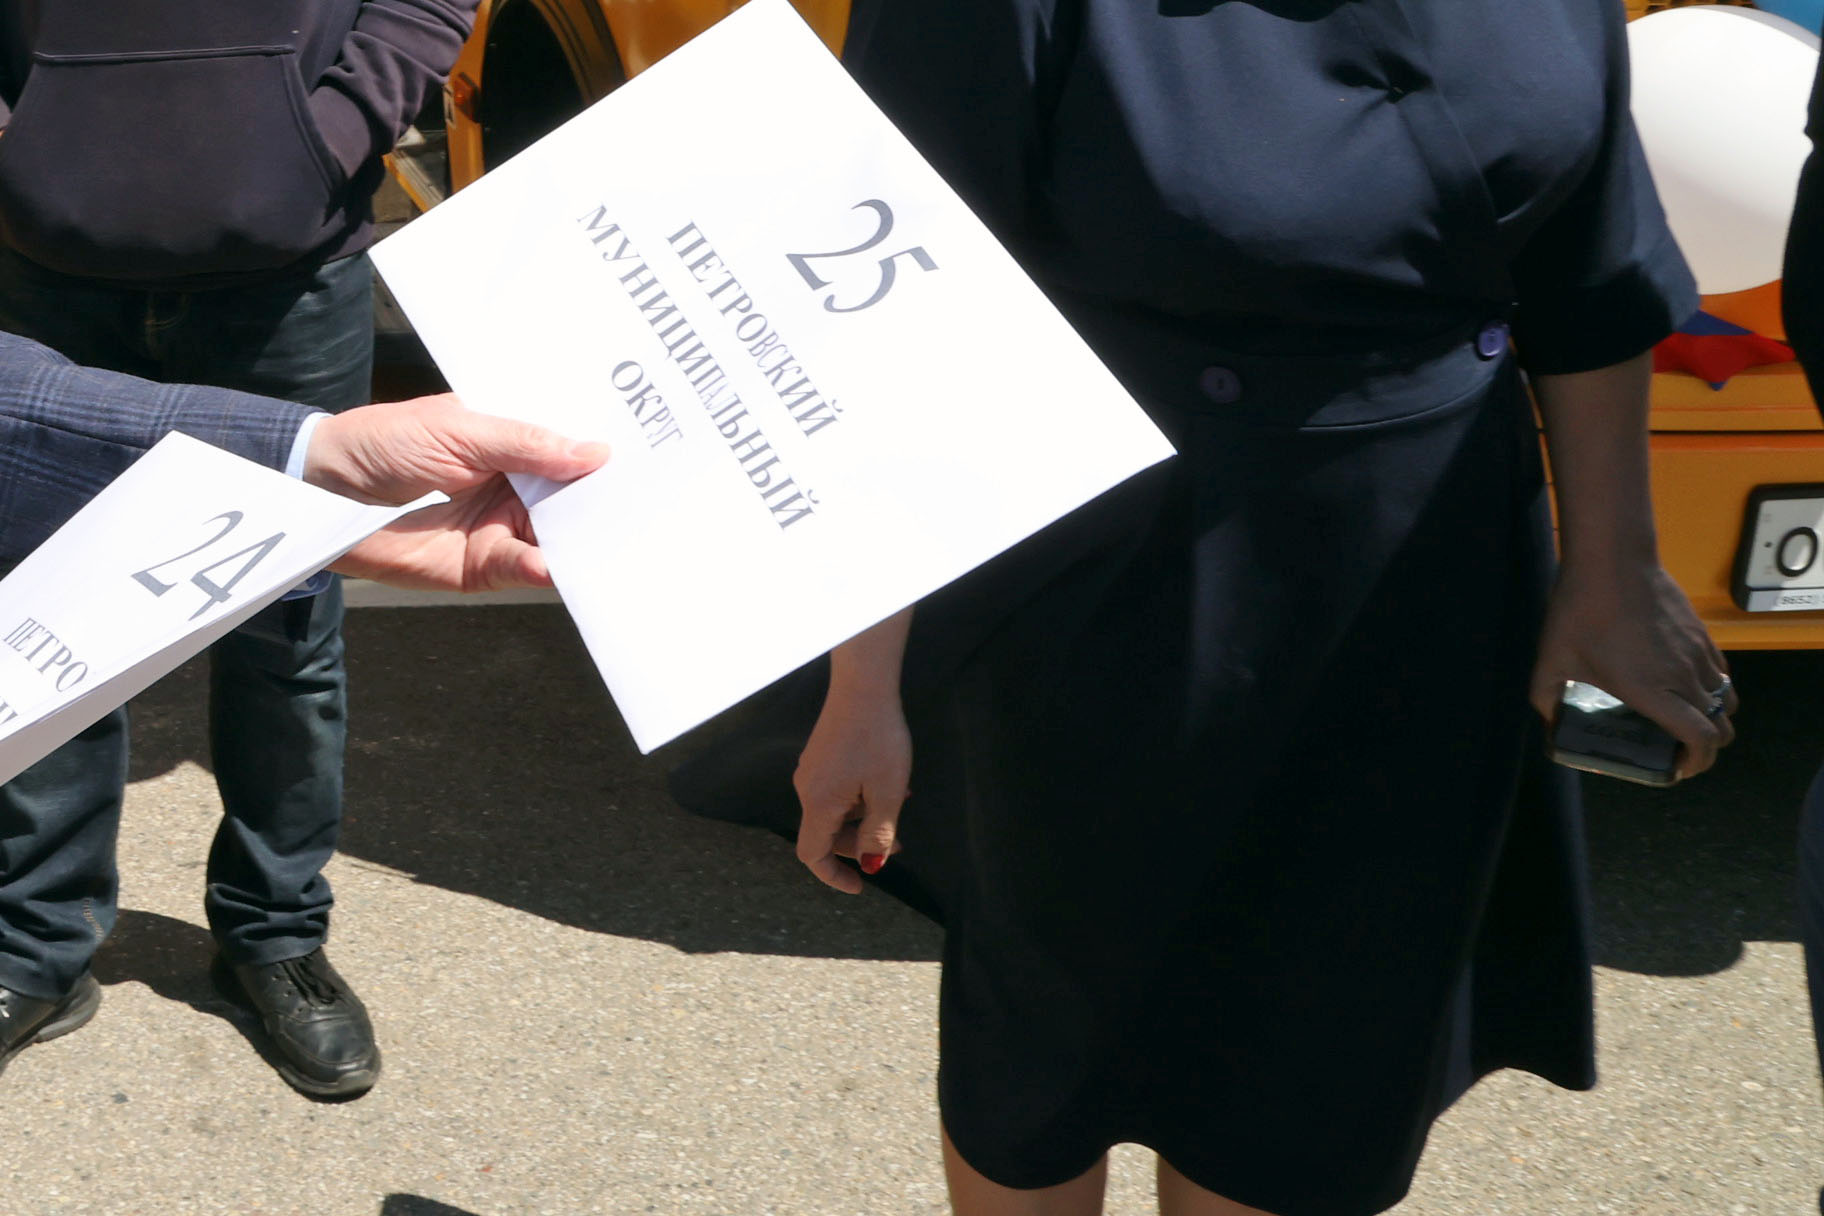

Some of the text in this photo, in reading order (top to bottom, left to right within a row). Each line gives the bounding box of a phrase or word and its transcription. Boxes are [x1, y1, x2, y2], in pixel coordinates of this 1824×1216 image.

[785, 197, 940, 314] 25
[576, 201, 820, 531] МУНИЦИПАЛЬНЫЙ
[665, 218, 844, 439] ПЕТРОВСКИЙ
[610, 359, 684, 449] ОКРУГ
[129, 510, 287, 622] 24
[2, 616, 89, 693] ПЕТРО
